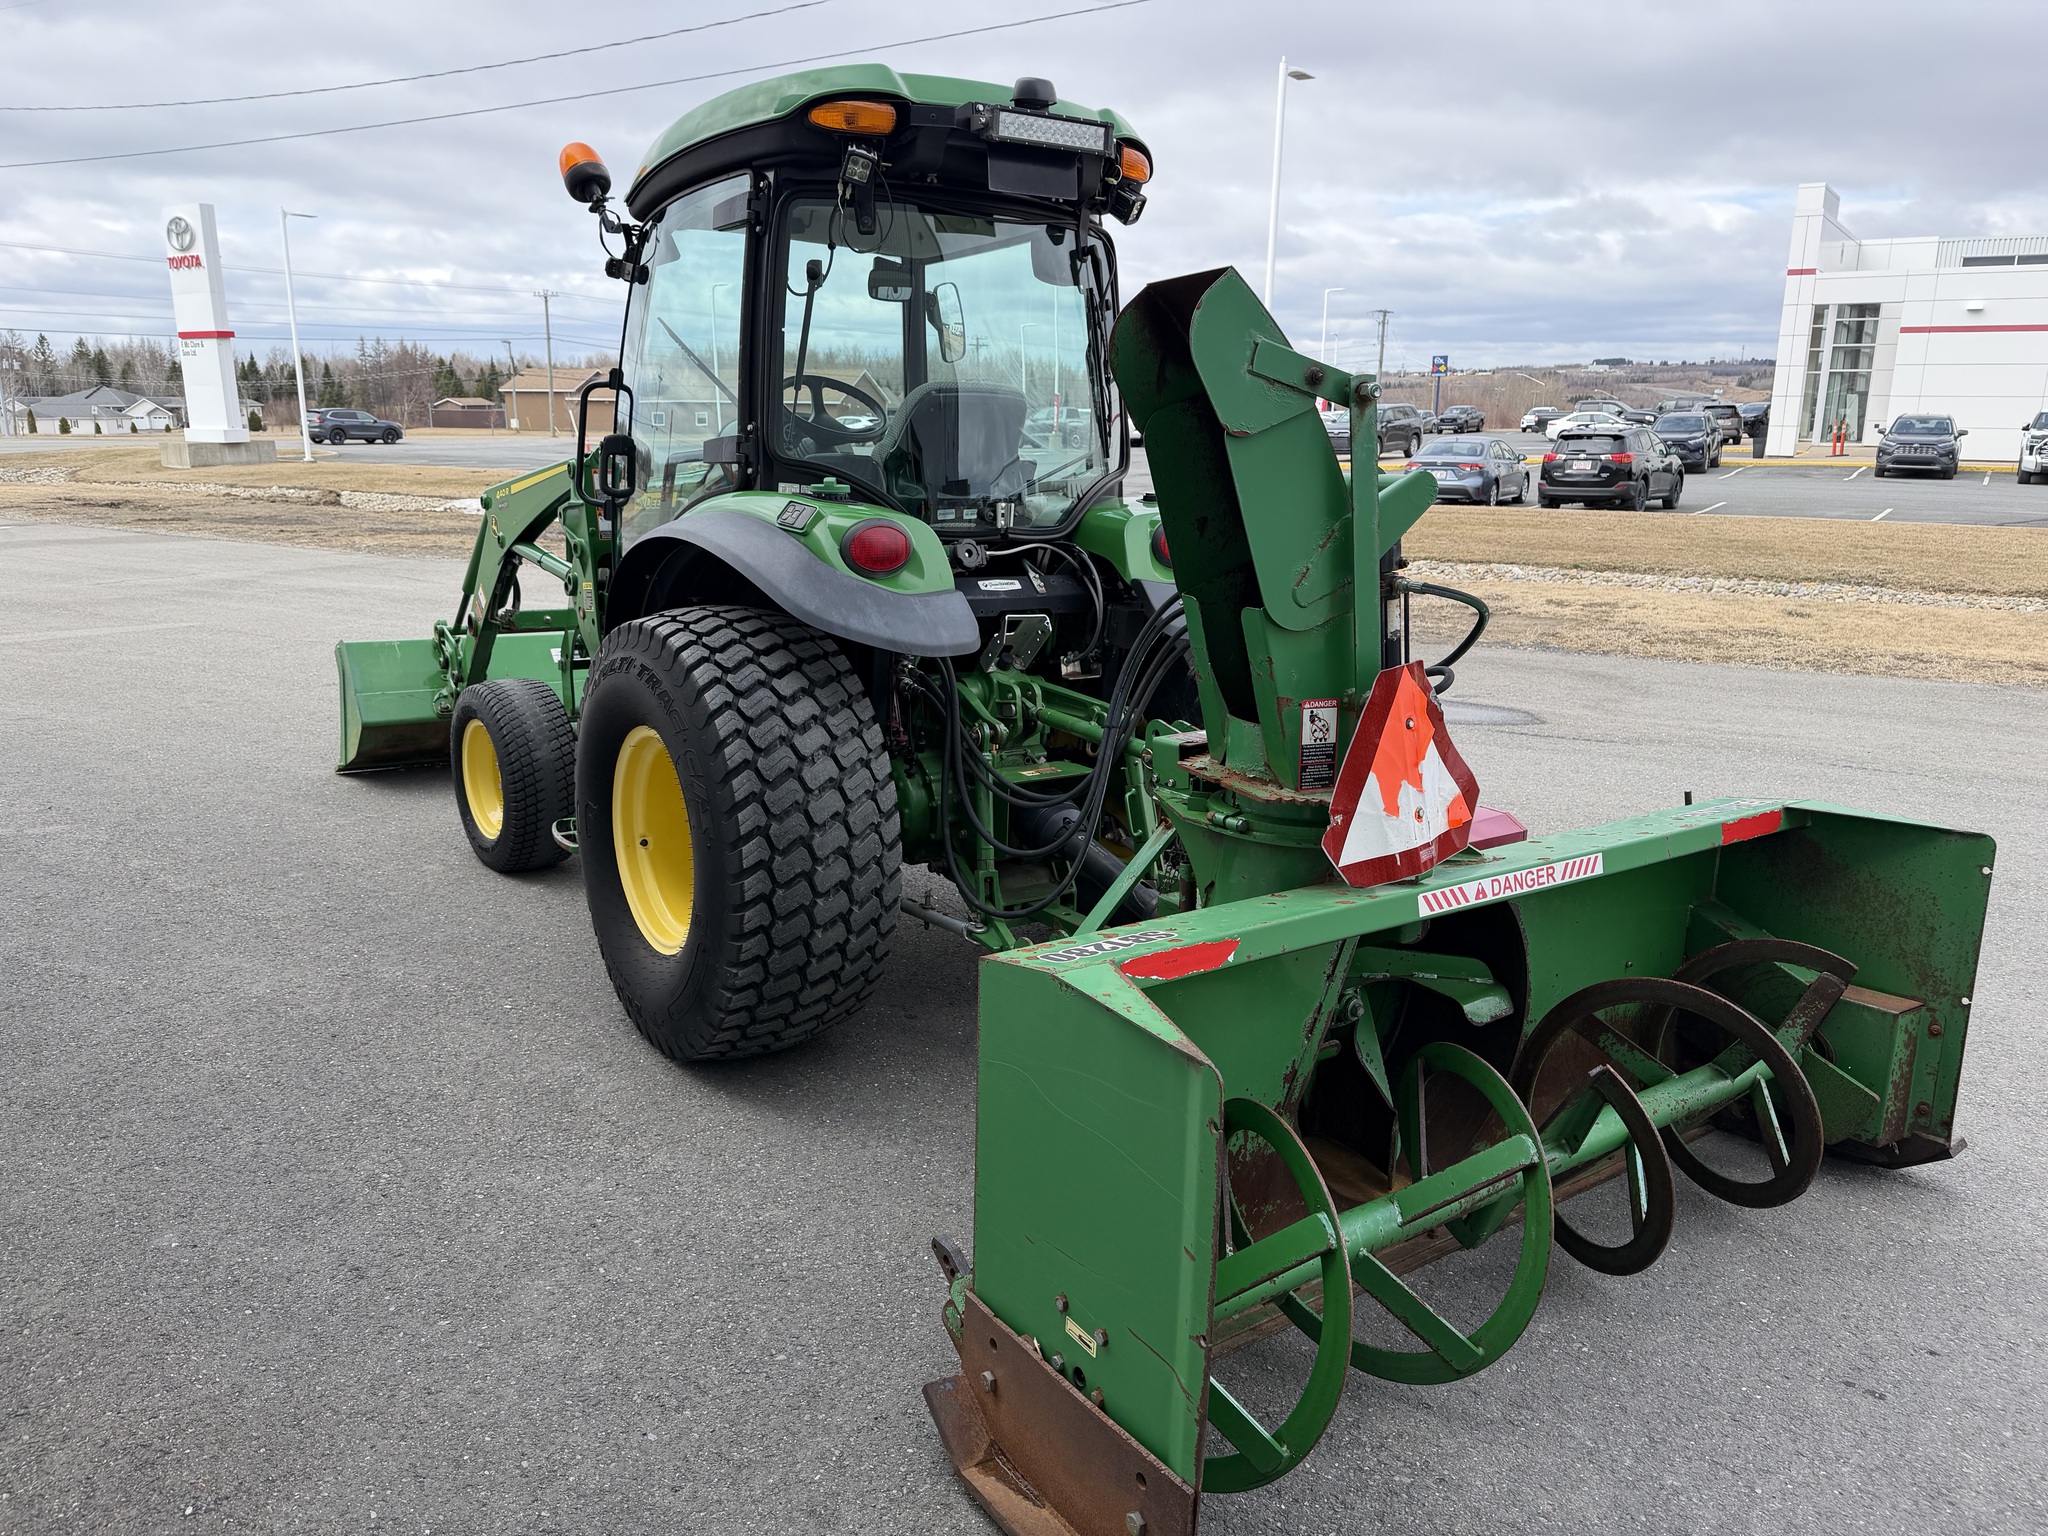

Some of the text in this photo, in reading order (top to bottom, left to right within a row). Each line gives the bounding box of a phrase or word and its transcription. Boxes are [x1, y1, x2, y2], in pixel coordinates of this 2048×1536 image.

[167, 254, 202, 269] TOYOTA
[1309, 700, 1338, 708] DANGER
[1490, 865, 1557, 898] DANGER
[1037, 931, 1179, 963] SB1280
